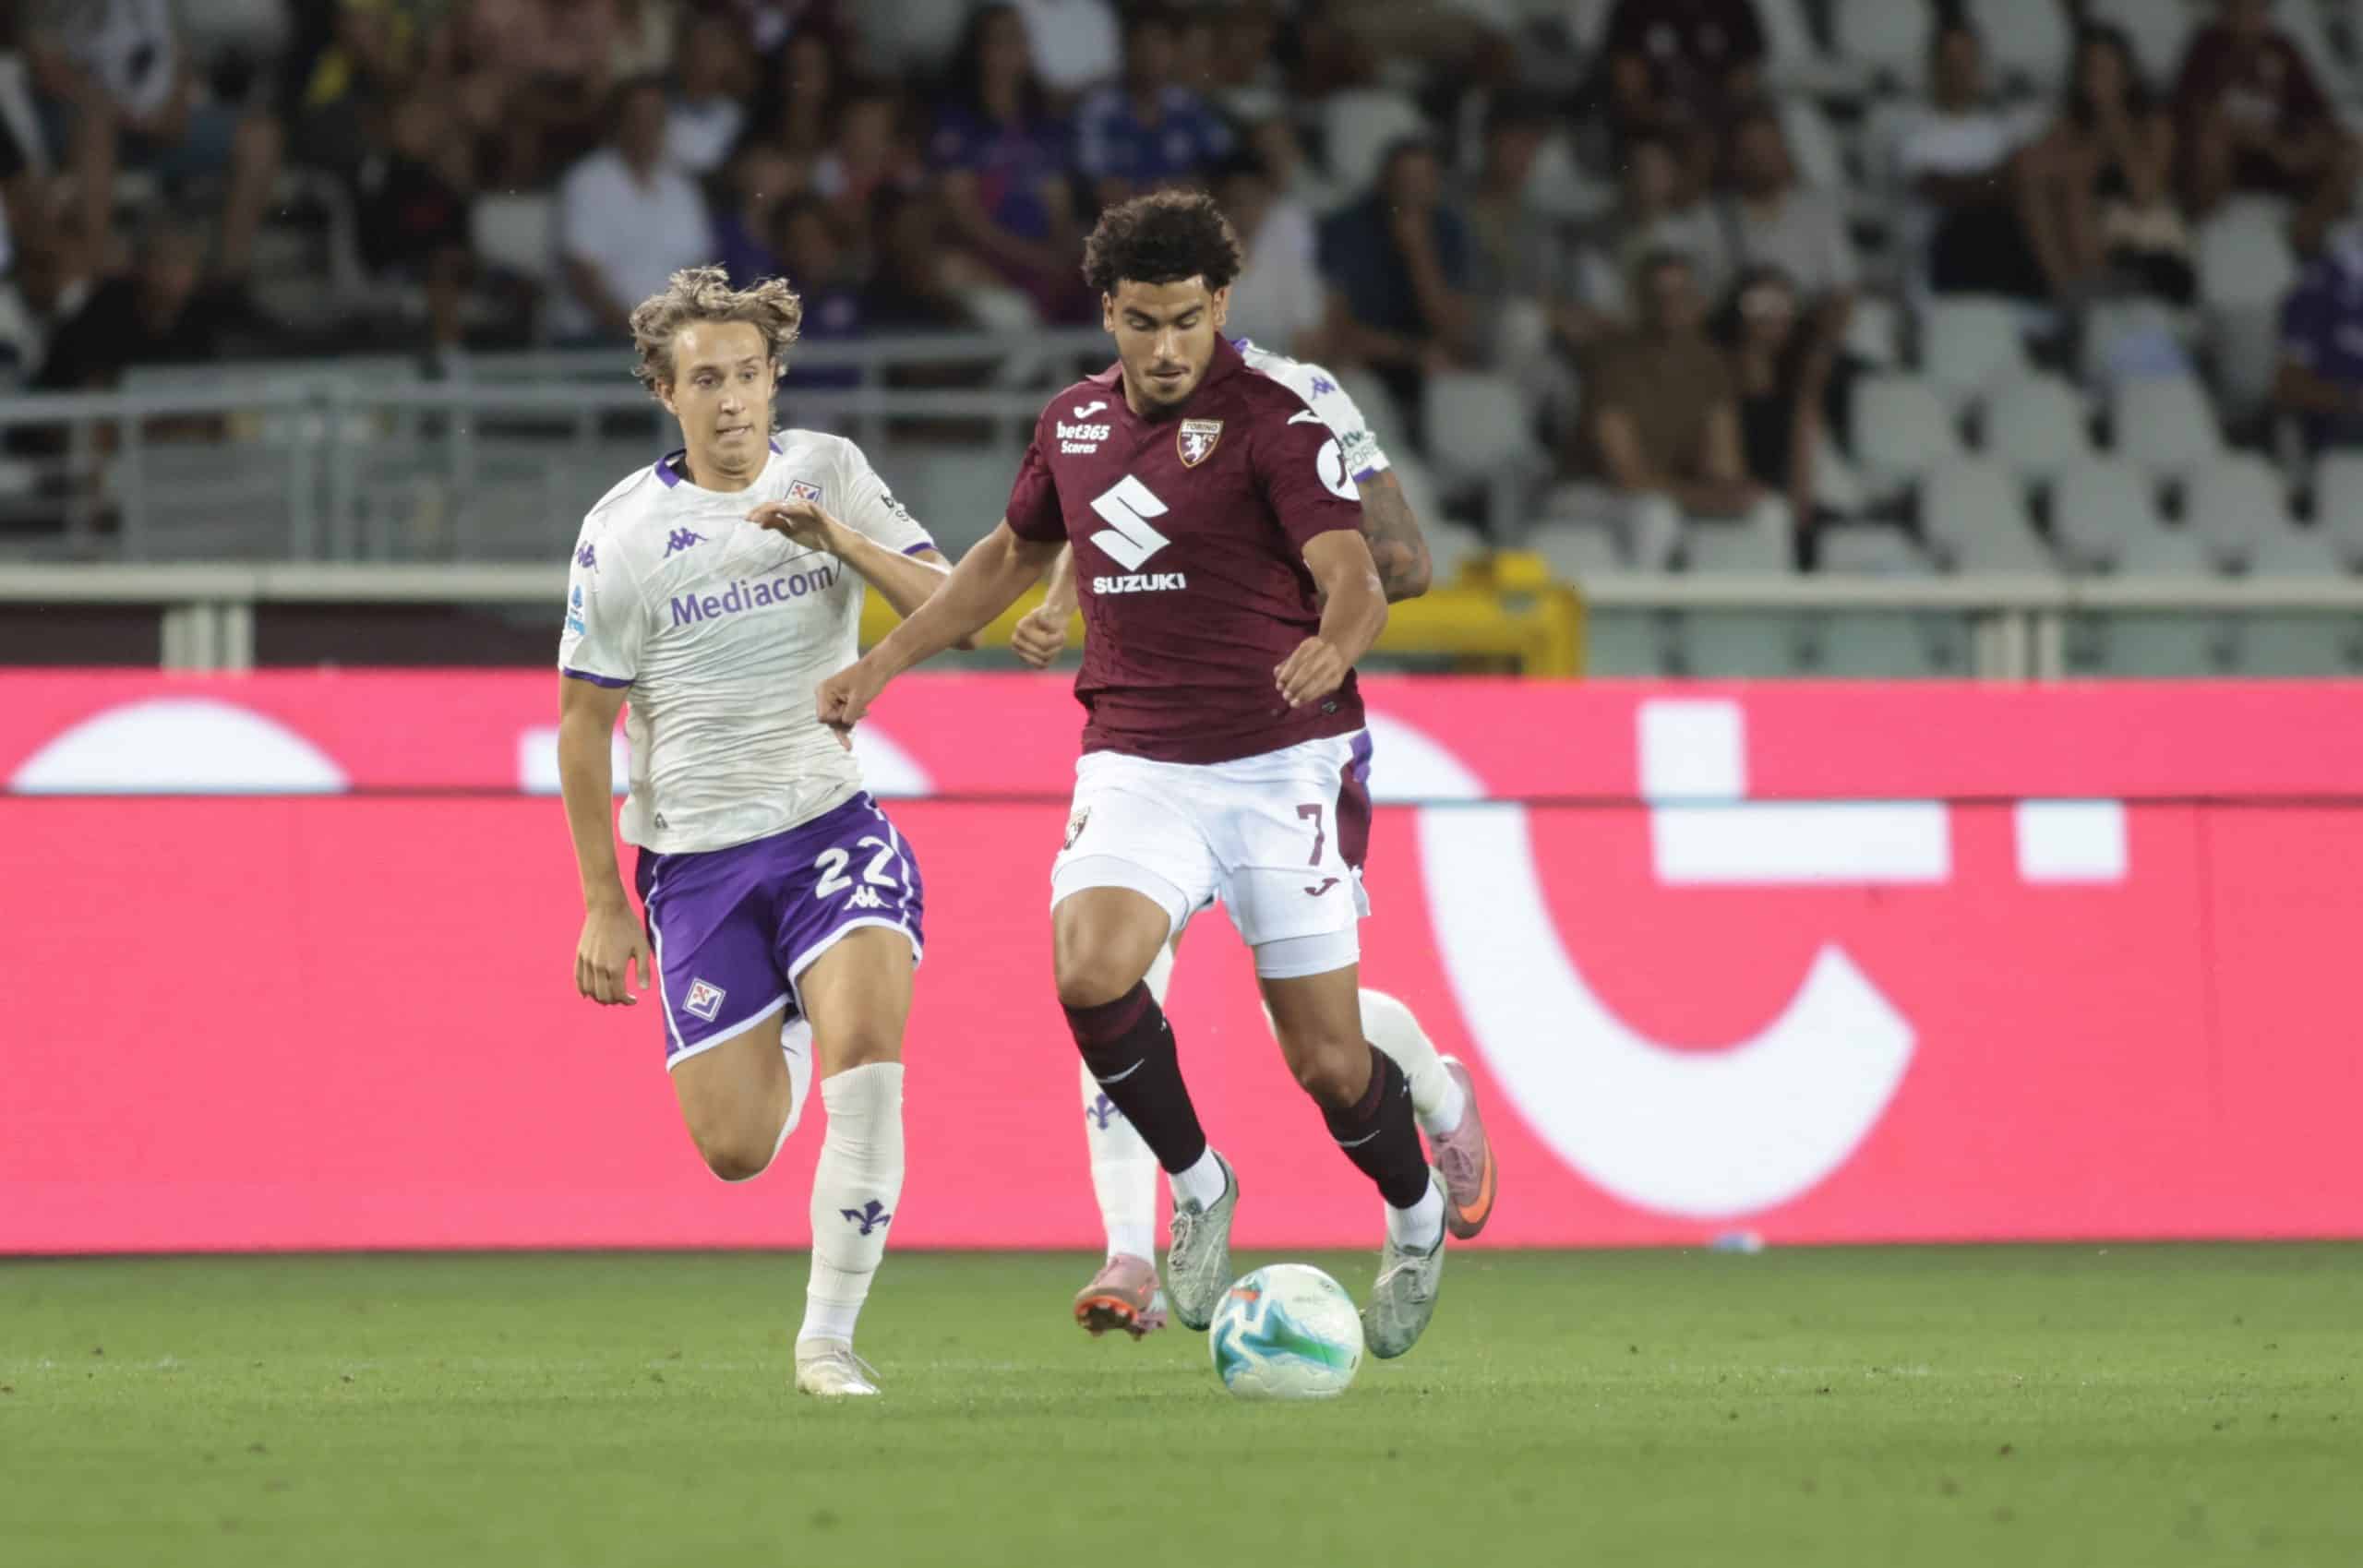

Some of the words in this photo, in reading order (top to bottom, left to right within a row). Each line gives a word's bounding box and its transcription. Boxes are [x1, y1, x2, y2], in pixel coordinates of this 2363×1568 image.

[1056, 420, 1111, 441] bet365
[1061, 439, 1098, 454] Scores
[670, 566, 834, 627] Mediacom
[1093, 572, 1186, 594] SUZUKI
[1296, 804, 1325, 866] 7
[814, 836, 899, 899] 22
